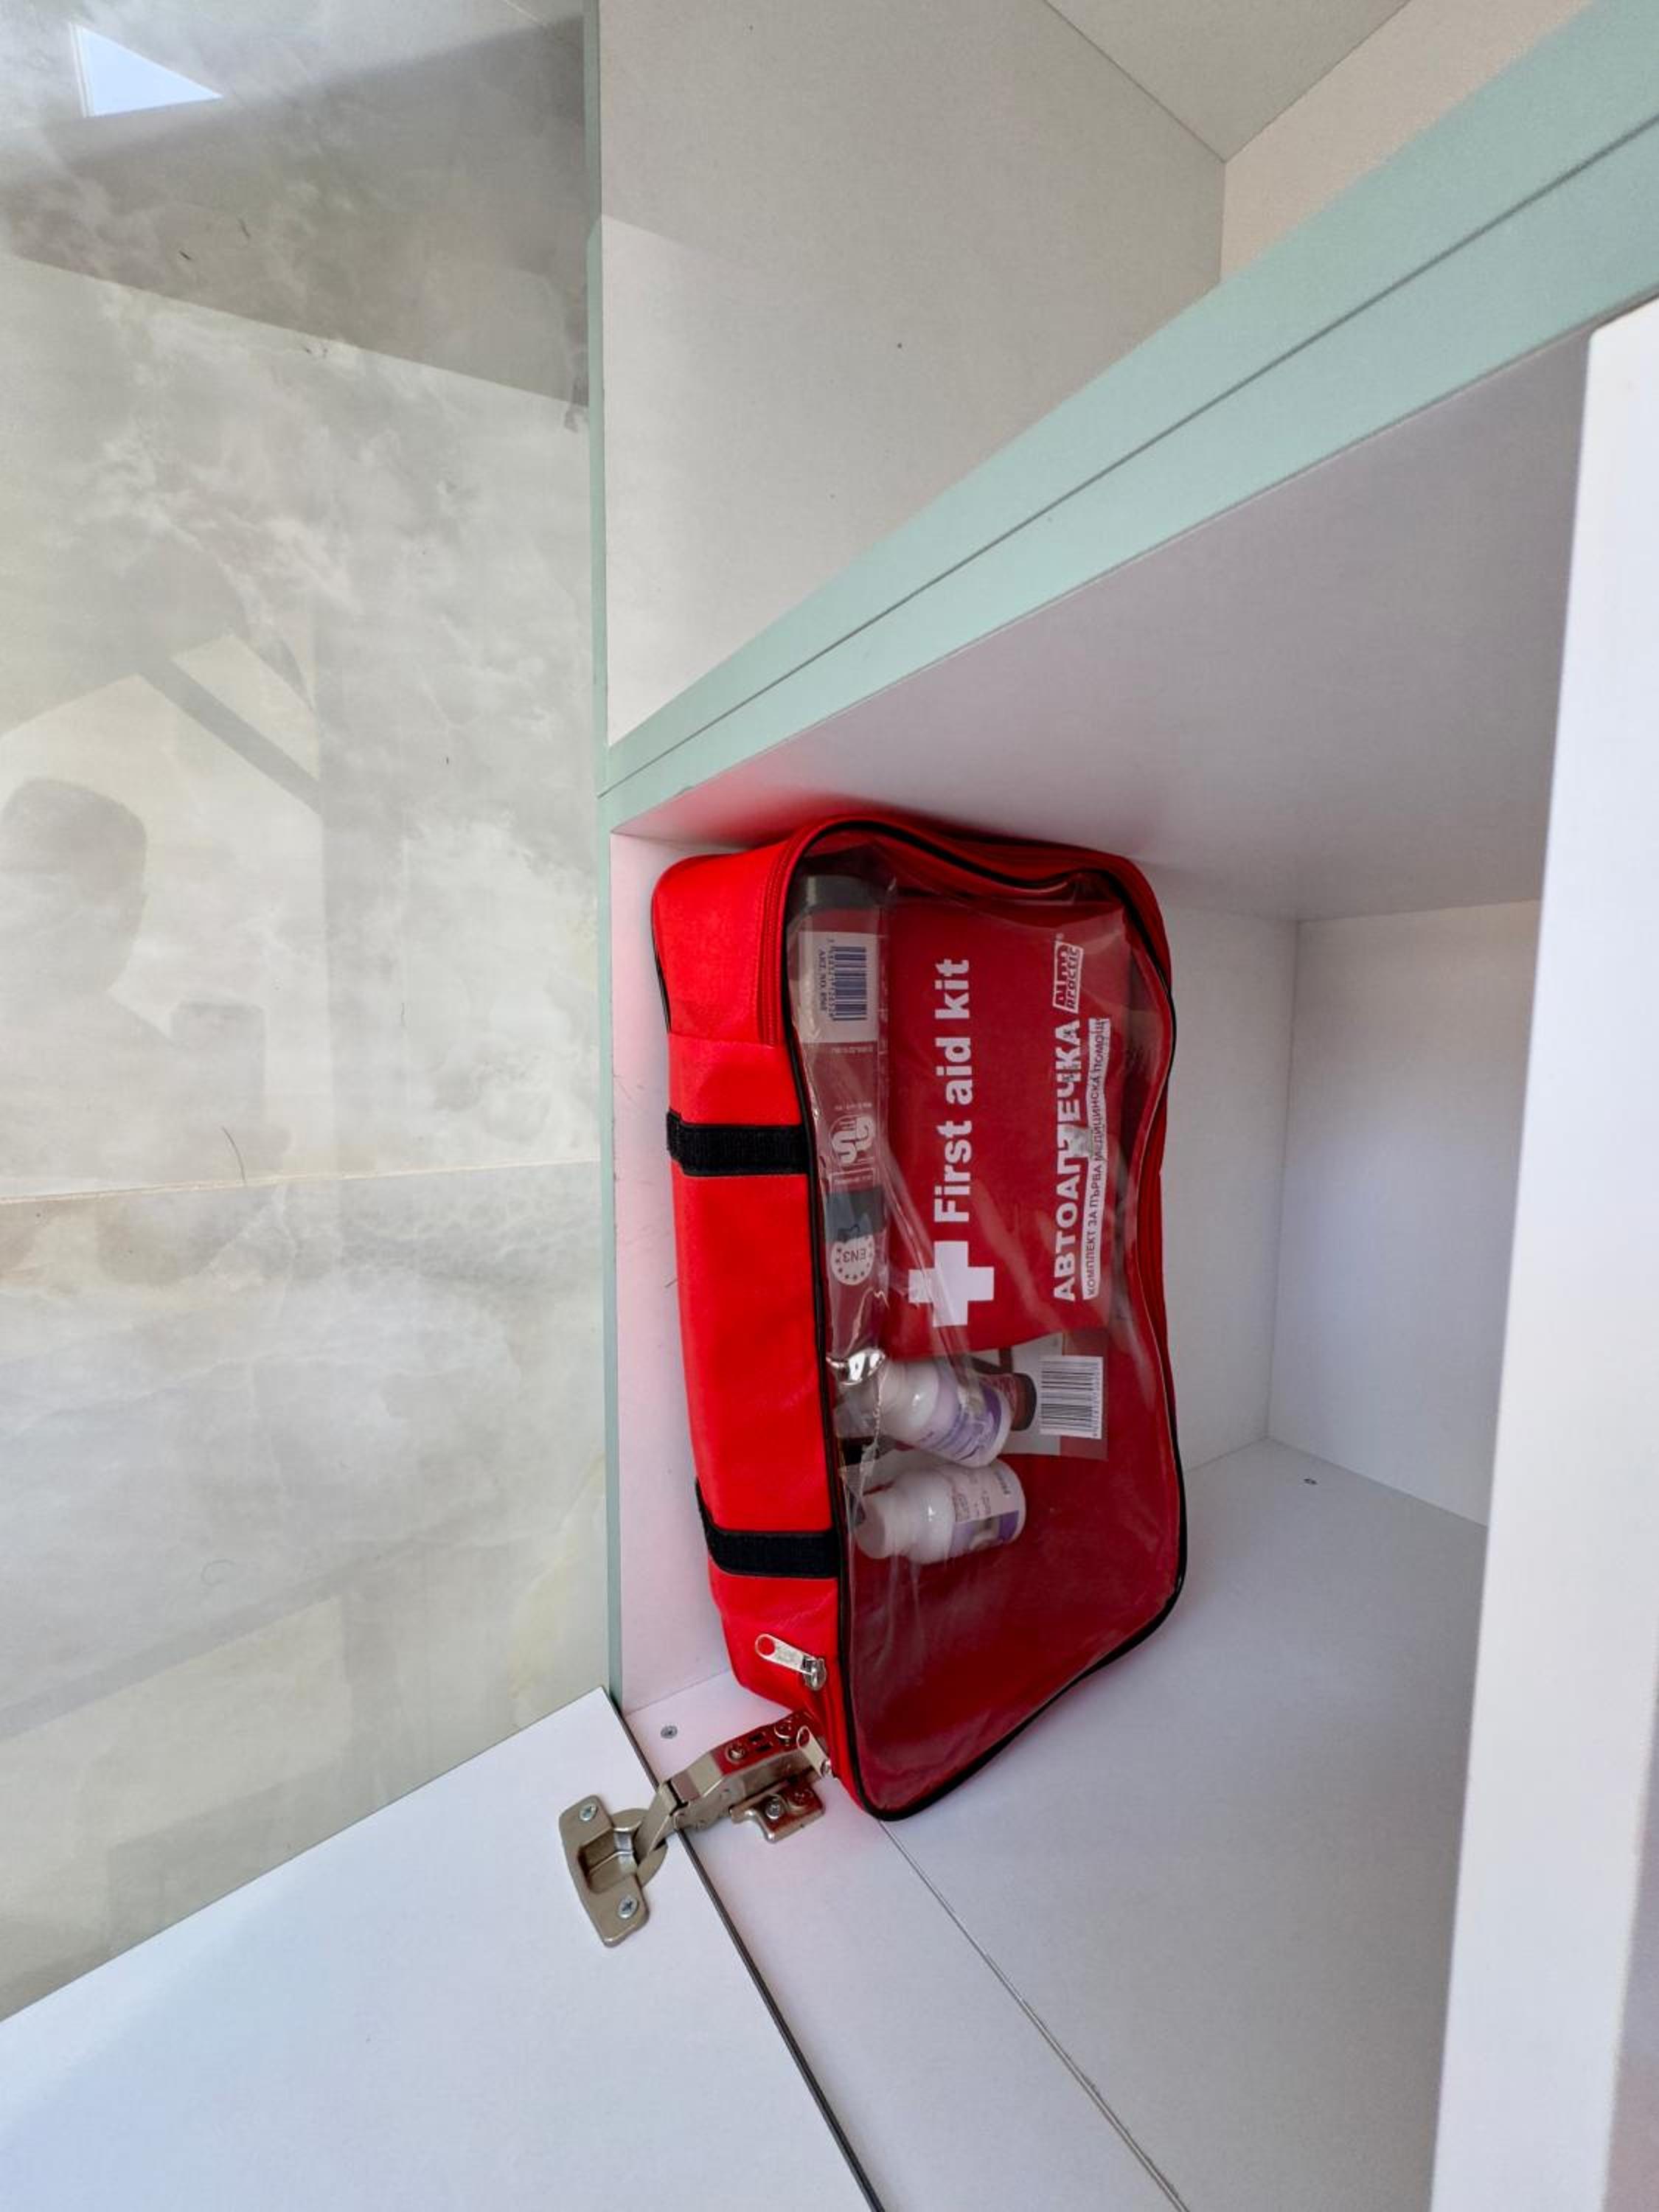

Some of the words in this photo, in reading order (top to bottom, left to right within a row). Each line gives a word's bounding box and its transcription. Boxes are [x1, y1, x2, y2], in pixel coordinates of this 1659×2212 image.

[935, 959, 970, 1019] kit
[936, 1037, 972, 1105] aid
[934, 1121, 972, 1222] First
[1089, 1164, 1102, 1208] ПЪРВА
[1088, 1211, 1099, 1227] ЗА
[842, 1248, 867, 1263] EN3
[1085, 1231, 1096, 1295] КОМПЛЕКТ
